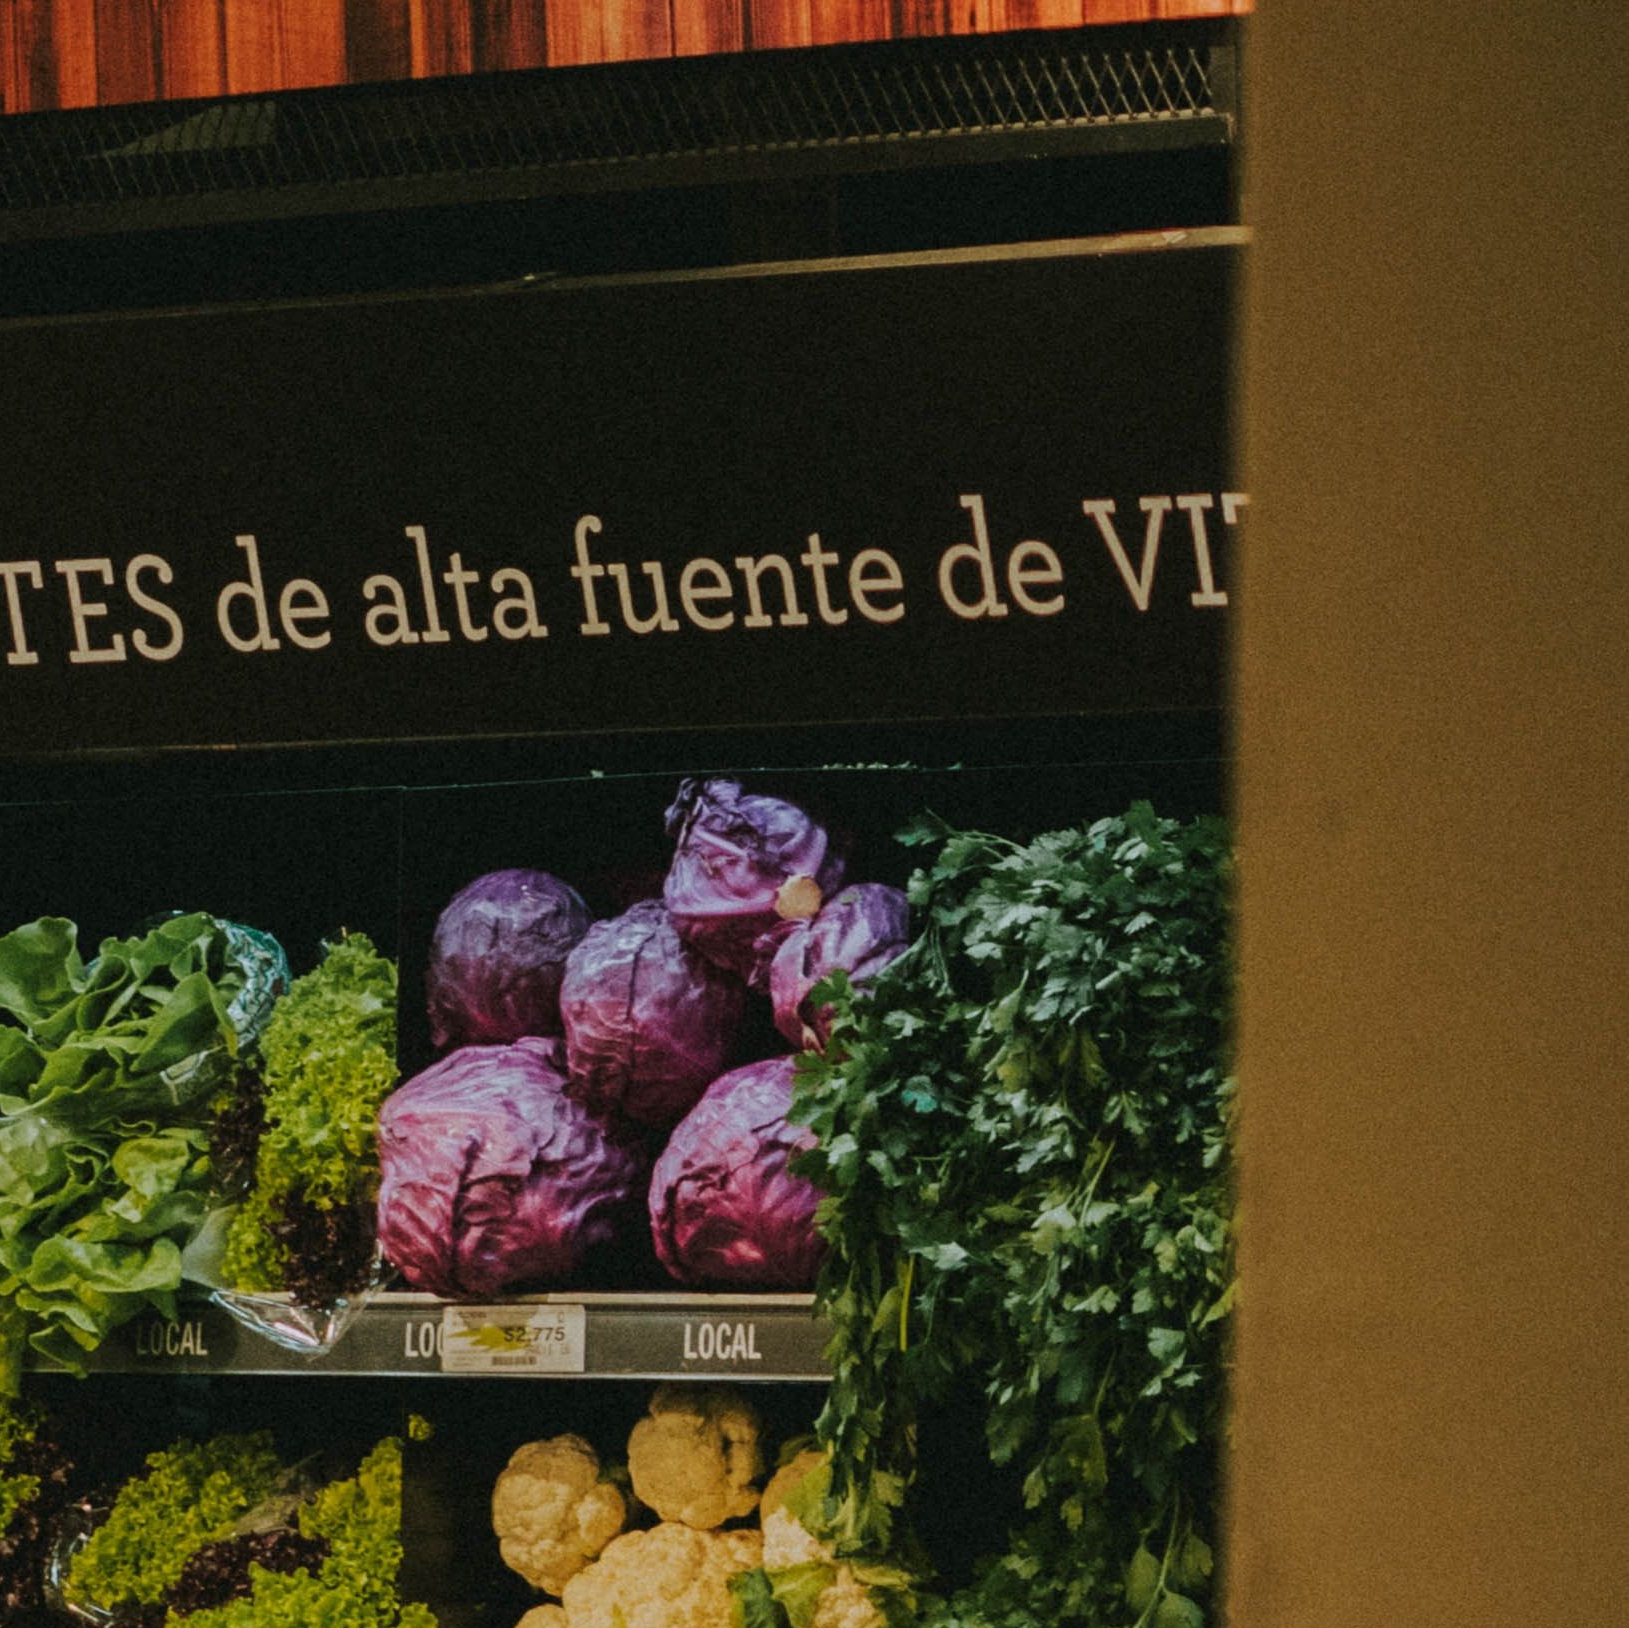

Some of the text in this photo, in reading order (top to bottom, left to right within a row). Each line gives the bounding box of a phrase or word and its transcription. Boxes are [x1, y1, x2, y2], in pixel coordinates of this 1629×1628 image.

[217, 535, 332, 652] de
[362, 525, 548, 646] alta
[570, 515, 905, 636] fuente
[941, 494, 1066, 619] de
[684, 1322, 762, 1360] LOCAL
